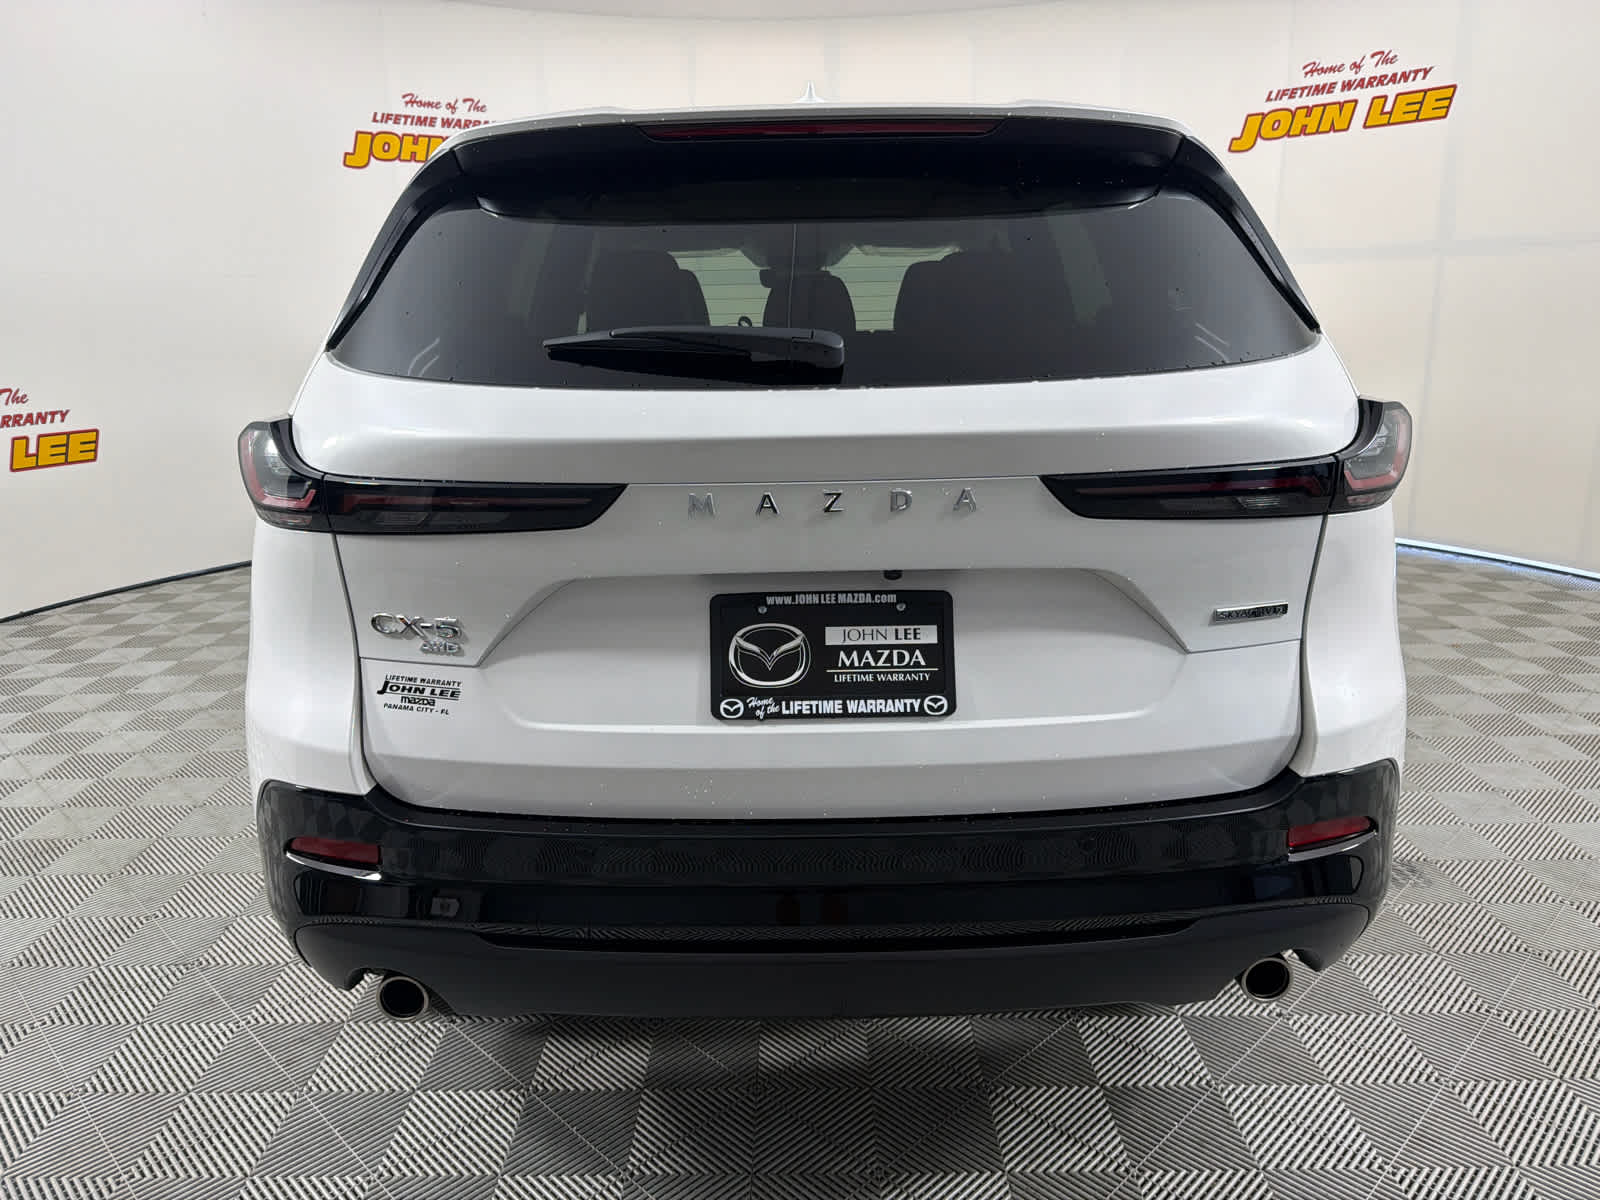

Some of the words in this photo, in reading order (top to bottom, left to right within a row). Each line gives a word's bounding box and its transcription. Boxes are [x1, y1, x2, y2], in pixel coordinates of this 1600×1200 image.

[1302, 61, 1345, 78] Home
[1349, 55, 1366, 75] of
[1370, 49, 1398, 68] The
[1265, 81, 1337, 102] LIFETIME
[1340, 66, 1434, 92] WARRANTY
[402, 92, 442, 110] Home
[445, 98, 459, 115] of
[462, 97, 487, 113] The
[371, 111, 438, 128] LIFETIME
[1228, 99, 1358, 152] JOHN
[1363, 84, 1457, 128] LEE
[10, 428, 99, 472] LEE
[688, 487, 977, 517] MAZDA
[820, 593, 836, 604] LEE
[838, 592, 897, 604] MAZDA.com
[371, 612, 460, 640] CX-5
[842, 628, 888, 643] JOHN
[894, 627, 921, 640] LEE
[838, 648, 926, 667] MAZDA
[385, 674, 418, 684] LIFETIME
[420, 678, 462, 688] WARRANTY
[834, 673, 874, 683] LIFETIME
[876, 672, 931, 681] WARRANTY
[376, 680, 426, 695] JOHN
[429, 688, 461, 699] LEE
[383, 702, 414, 713] PANAMA
[416, 706, 434, 714] CITY
[440, 708, 450, 716] FL
[747, 697, 774, 708] Home
[755, 706, 765, 719] of
[767, 702, 780, 714] the
[781, 700, 843, 715] LIFETIME
[846, 698, 921, 714] WARRANTY
